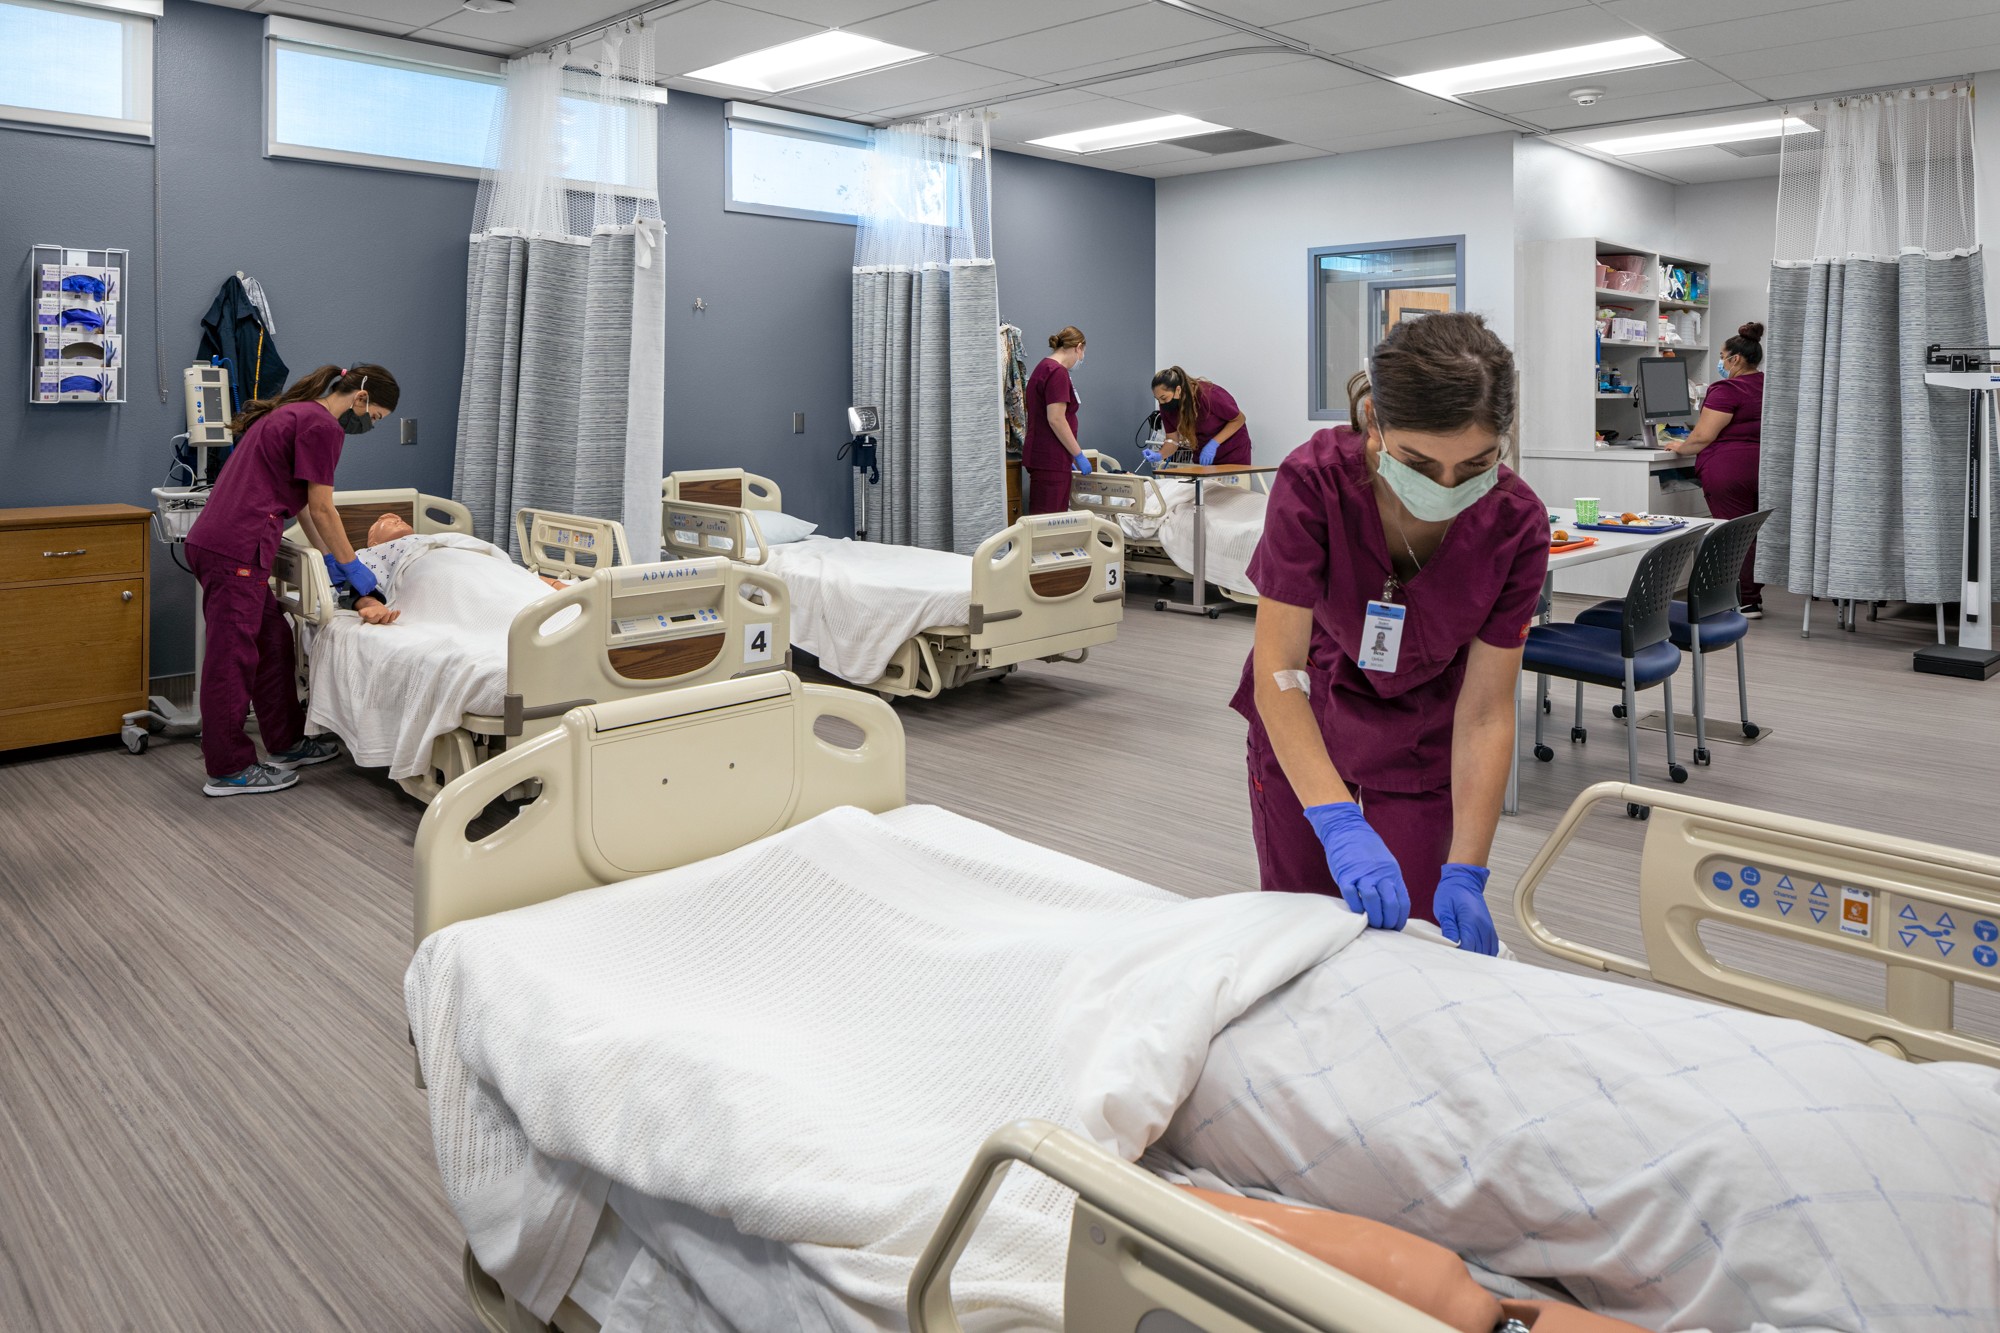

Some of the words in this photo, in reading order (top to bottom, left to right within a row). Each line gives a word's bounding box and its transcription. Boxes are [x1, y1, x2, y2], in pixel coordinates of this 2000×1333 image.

[1047, 518, 1077, 526] ADVANTA
[642, 567, 698, 581] ADVANTA
[1108, 569, 1117, 585] 3
[751, 630, 767, 653] 4
[1773, 890, 1797, 900] Channel
[1847, 887, 1860, 895] Call
[1808, 898, 1830, 908] Volume
